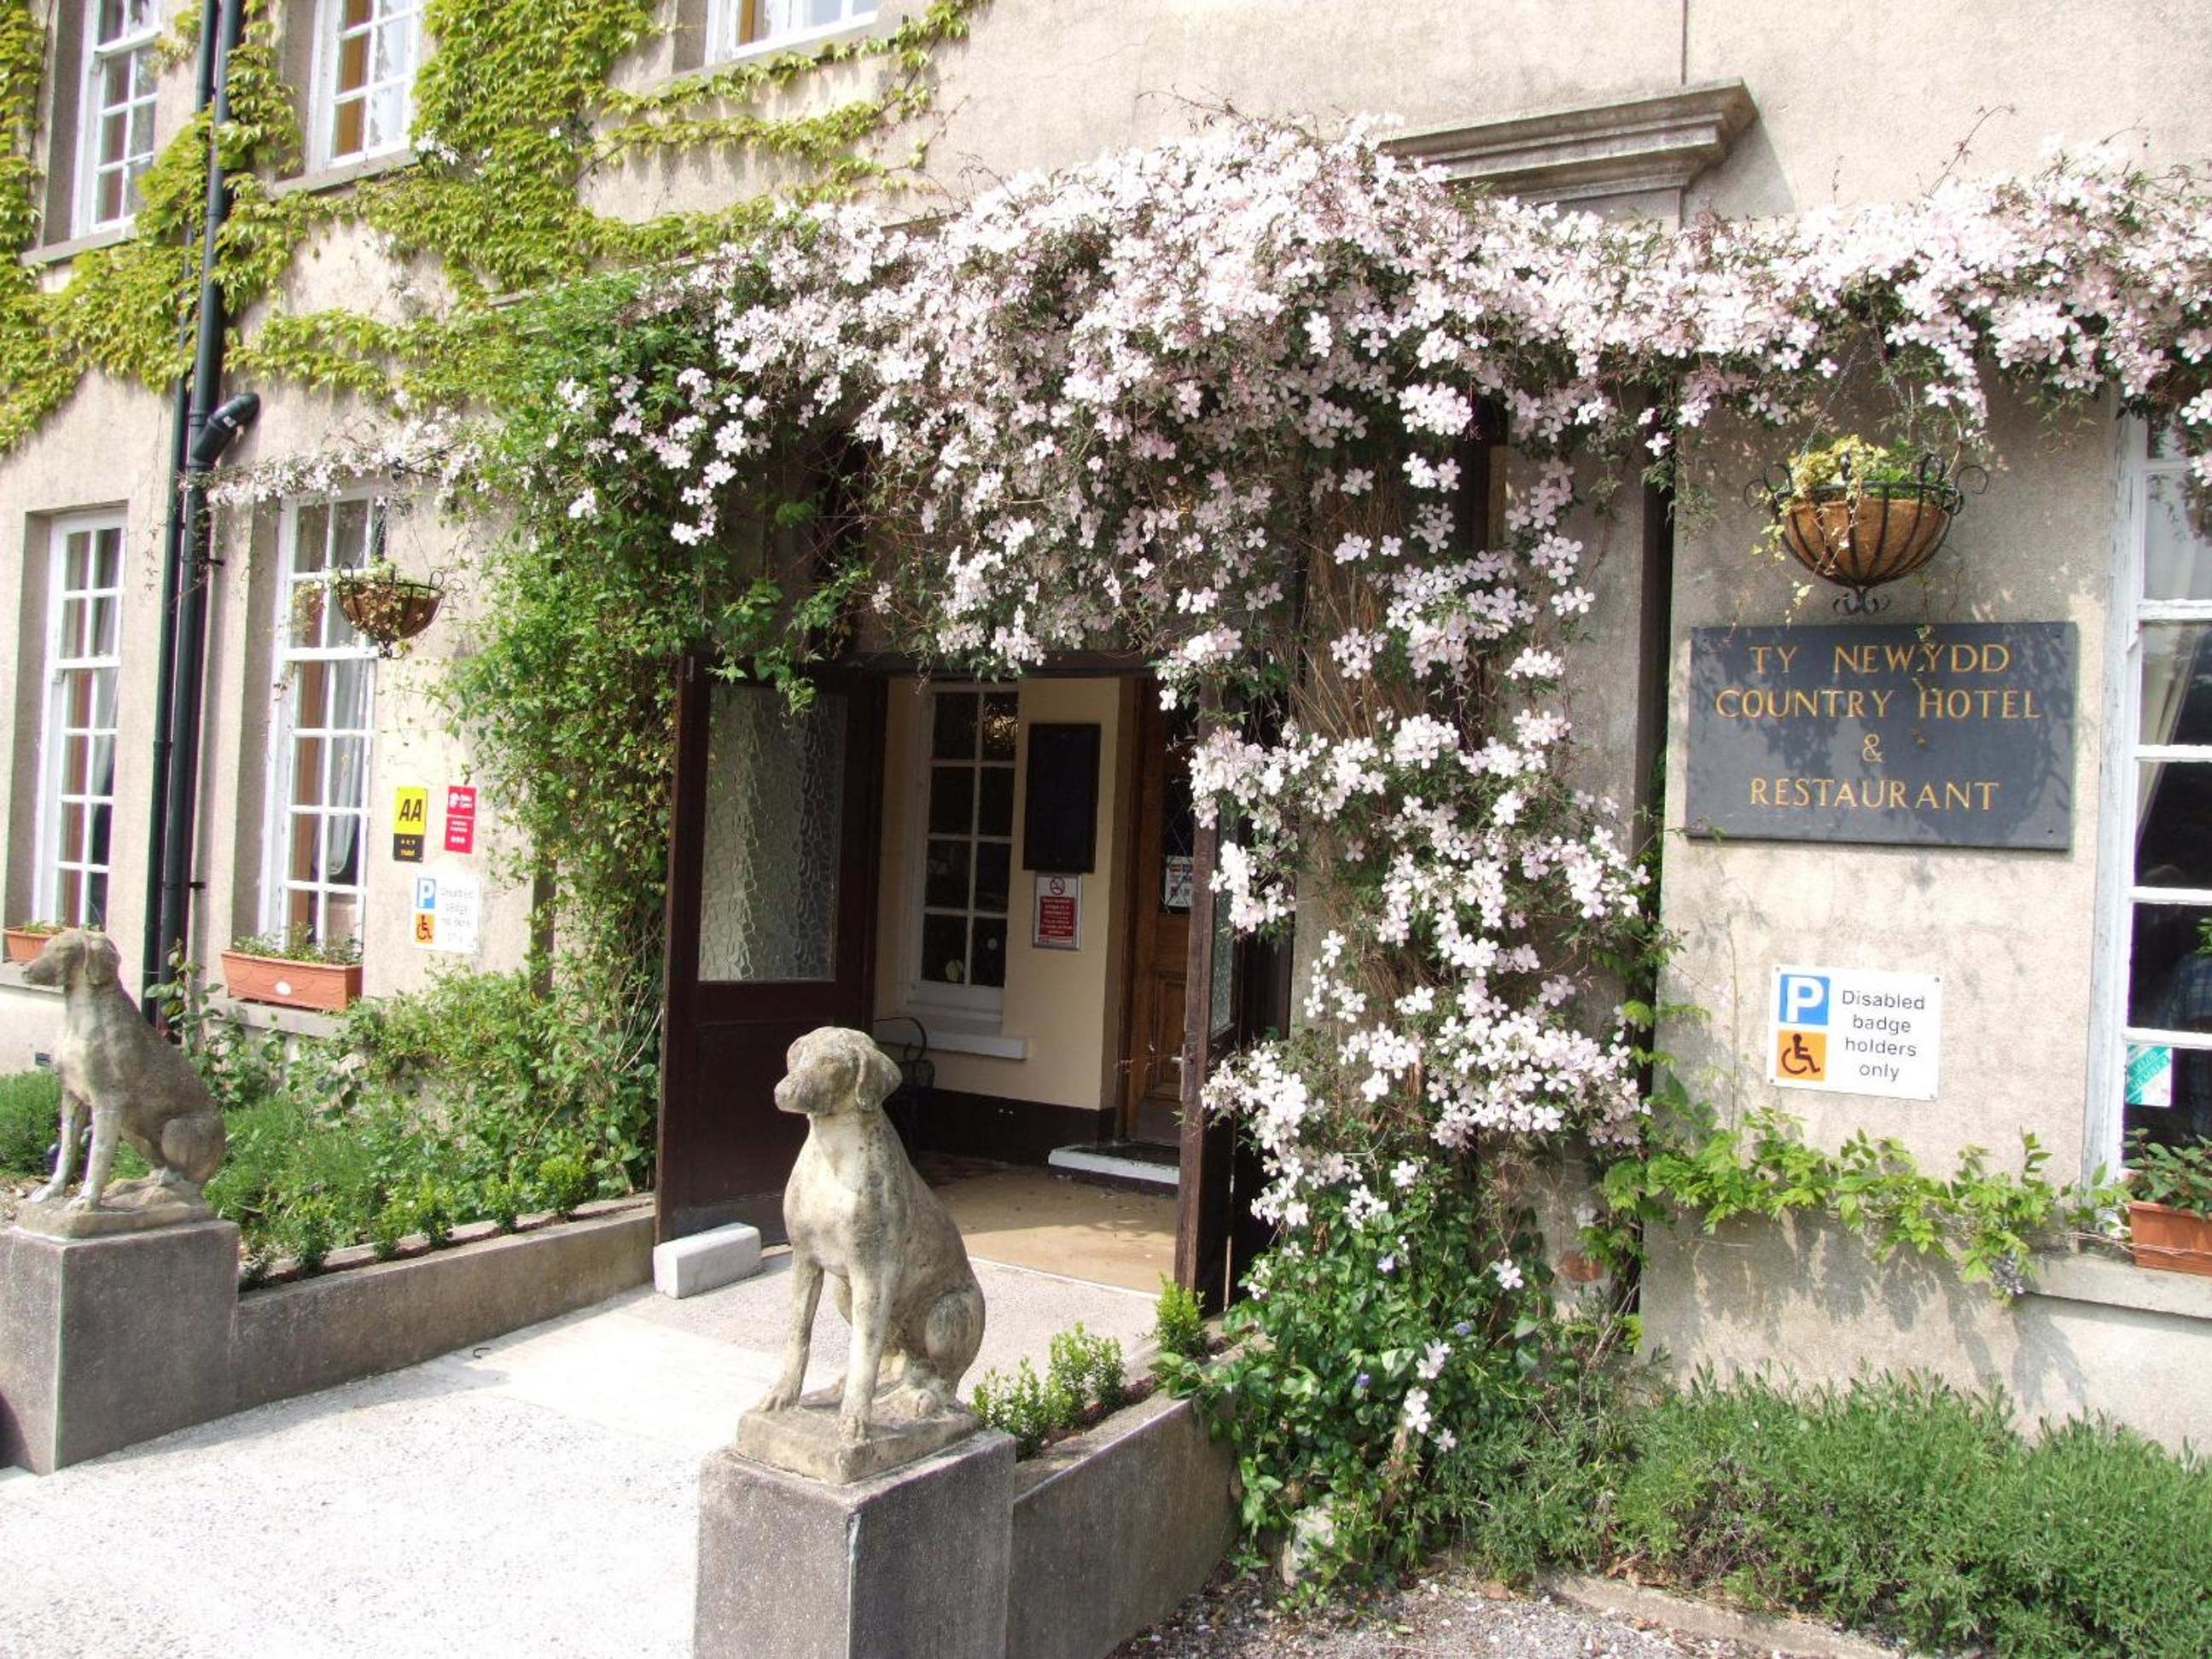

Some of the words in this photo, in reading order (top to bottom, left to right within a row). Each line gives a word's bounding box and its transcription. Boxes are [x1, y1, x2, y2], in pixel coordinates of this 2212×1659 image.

[1748, 644, 1798, 674] TY
[1833, 643, 2011, 673] NEWYDD
[1714, 689, 1894, 719] COUNTRY
[1918, 689, 2043, 719] HOTEL
[1861, 733, 1883, 763] &
[1749, 777, 2001, 812] RESTAURANT
[399, 798, 422, 822] AA
[419, 879, 435, 909] P
[1785, 976, 1824, 1024] P
[1842, 989, 1926, 1010] Disabled
[1852, 1014, 1912, 1035] badge
[1845, 1037, 1918, 1057] holders
[1859, 1063, 1901, 1083] only
